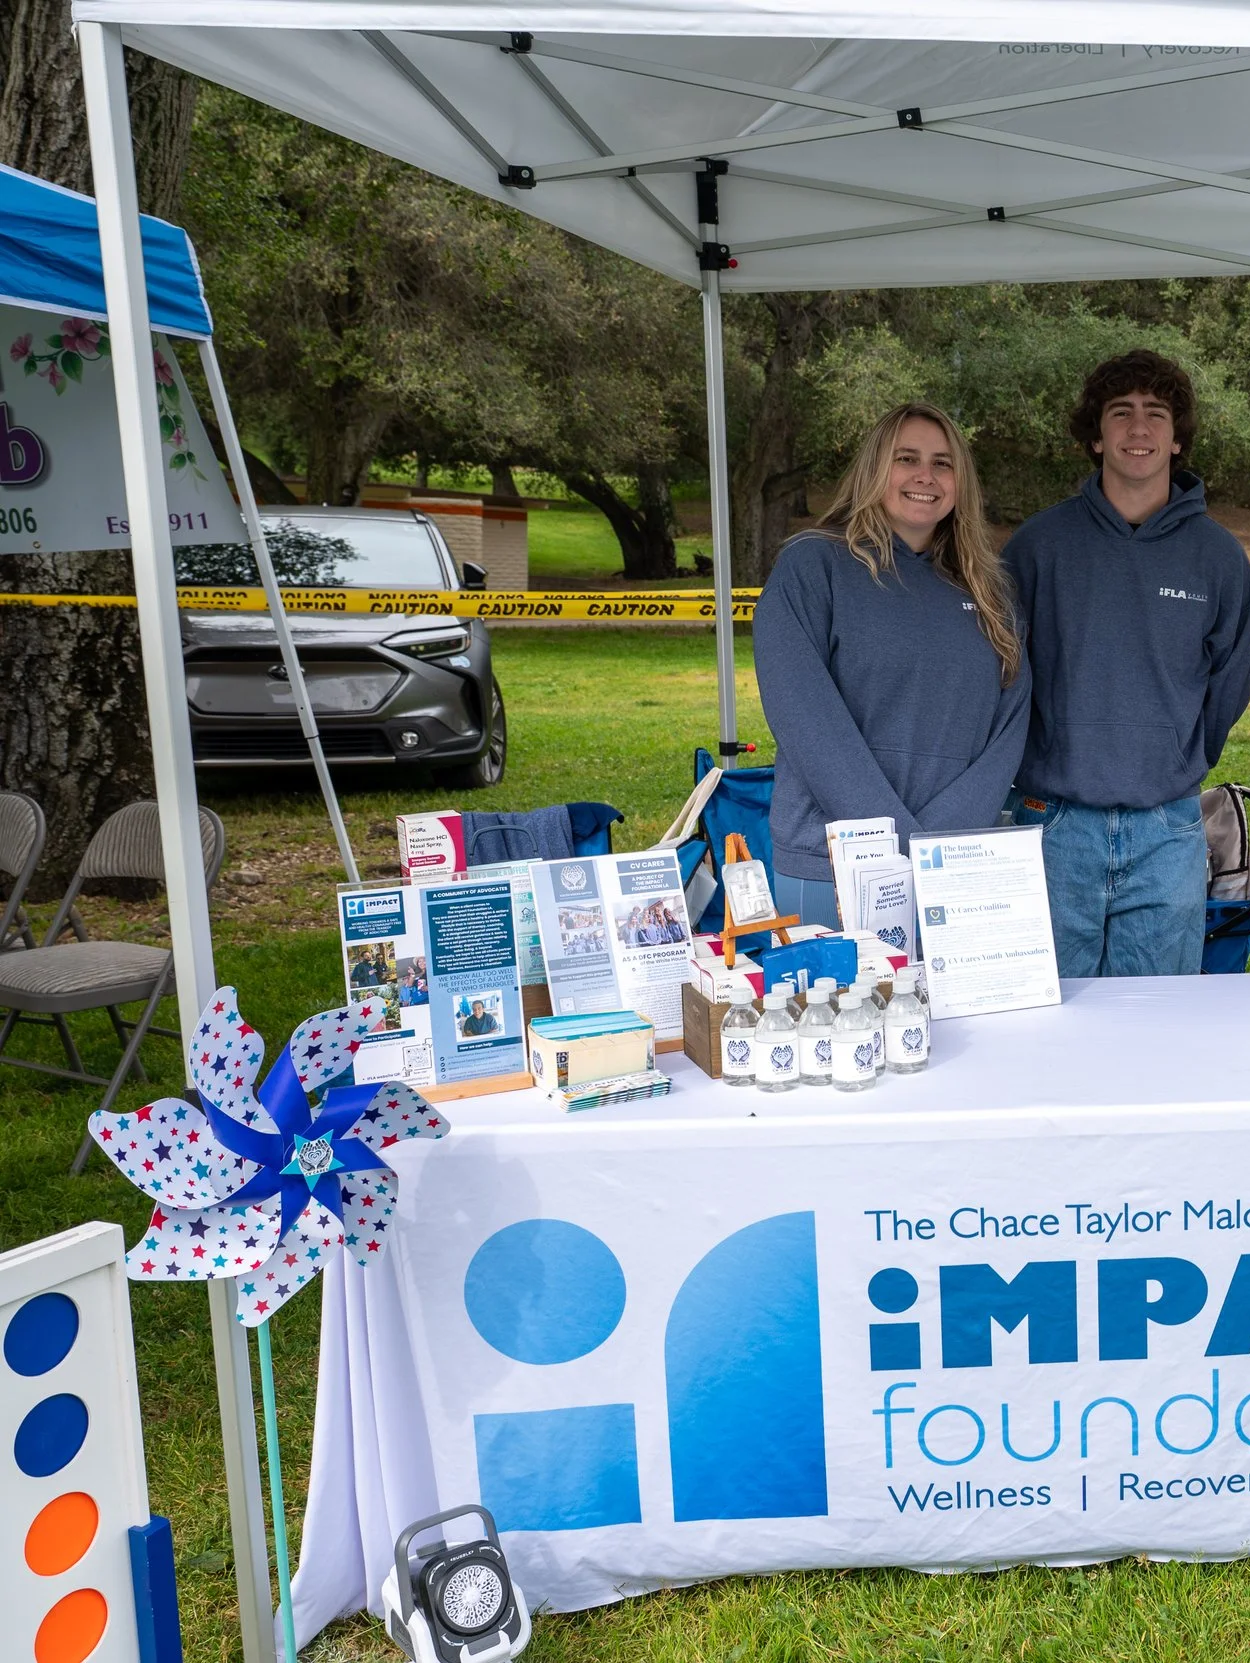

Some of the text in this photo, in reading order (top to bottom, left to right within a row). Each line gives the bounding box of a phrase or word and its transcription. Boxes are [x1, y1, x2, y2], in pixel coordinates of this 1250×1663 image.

[169, 512, 209, 532] 911
[370, 602, 453, 614] CAUTION
[477, 603, 563, 616] CAUTION
[587, 604, 675, 616] CAUTION
[944, 851, 983, 860] Foundation
[642, 860, 665, 868] CARES
[878, 880, 904, 892] Worried
[438, 890, 469, 898] COMMUNITY
[881, 888, 901, 897] About
[875, 898, 908, 911] You Love?
[876, 894, 906, 905] Someone
[958, 906, 978, 914] Cares
[979, 902, 1011, 912] Coalition
[653, 949, 687, 958] PROGRAM
[981, 952, 1003, 960] Youth
[1004, 948, 1049, 958] Ambassadors
[451, 979, 477, 987] EFFECTS
[480, 981, 515, 990] STRUGGLES
[865, 1210, 936, 1241] The
[949, 1207, 1060, 1240] Chace
[1065, 1200, 1172, 1244] Taylor
[887, 1480, 1052, 1512] Wellness
